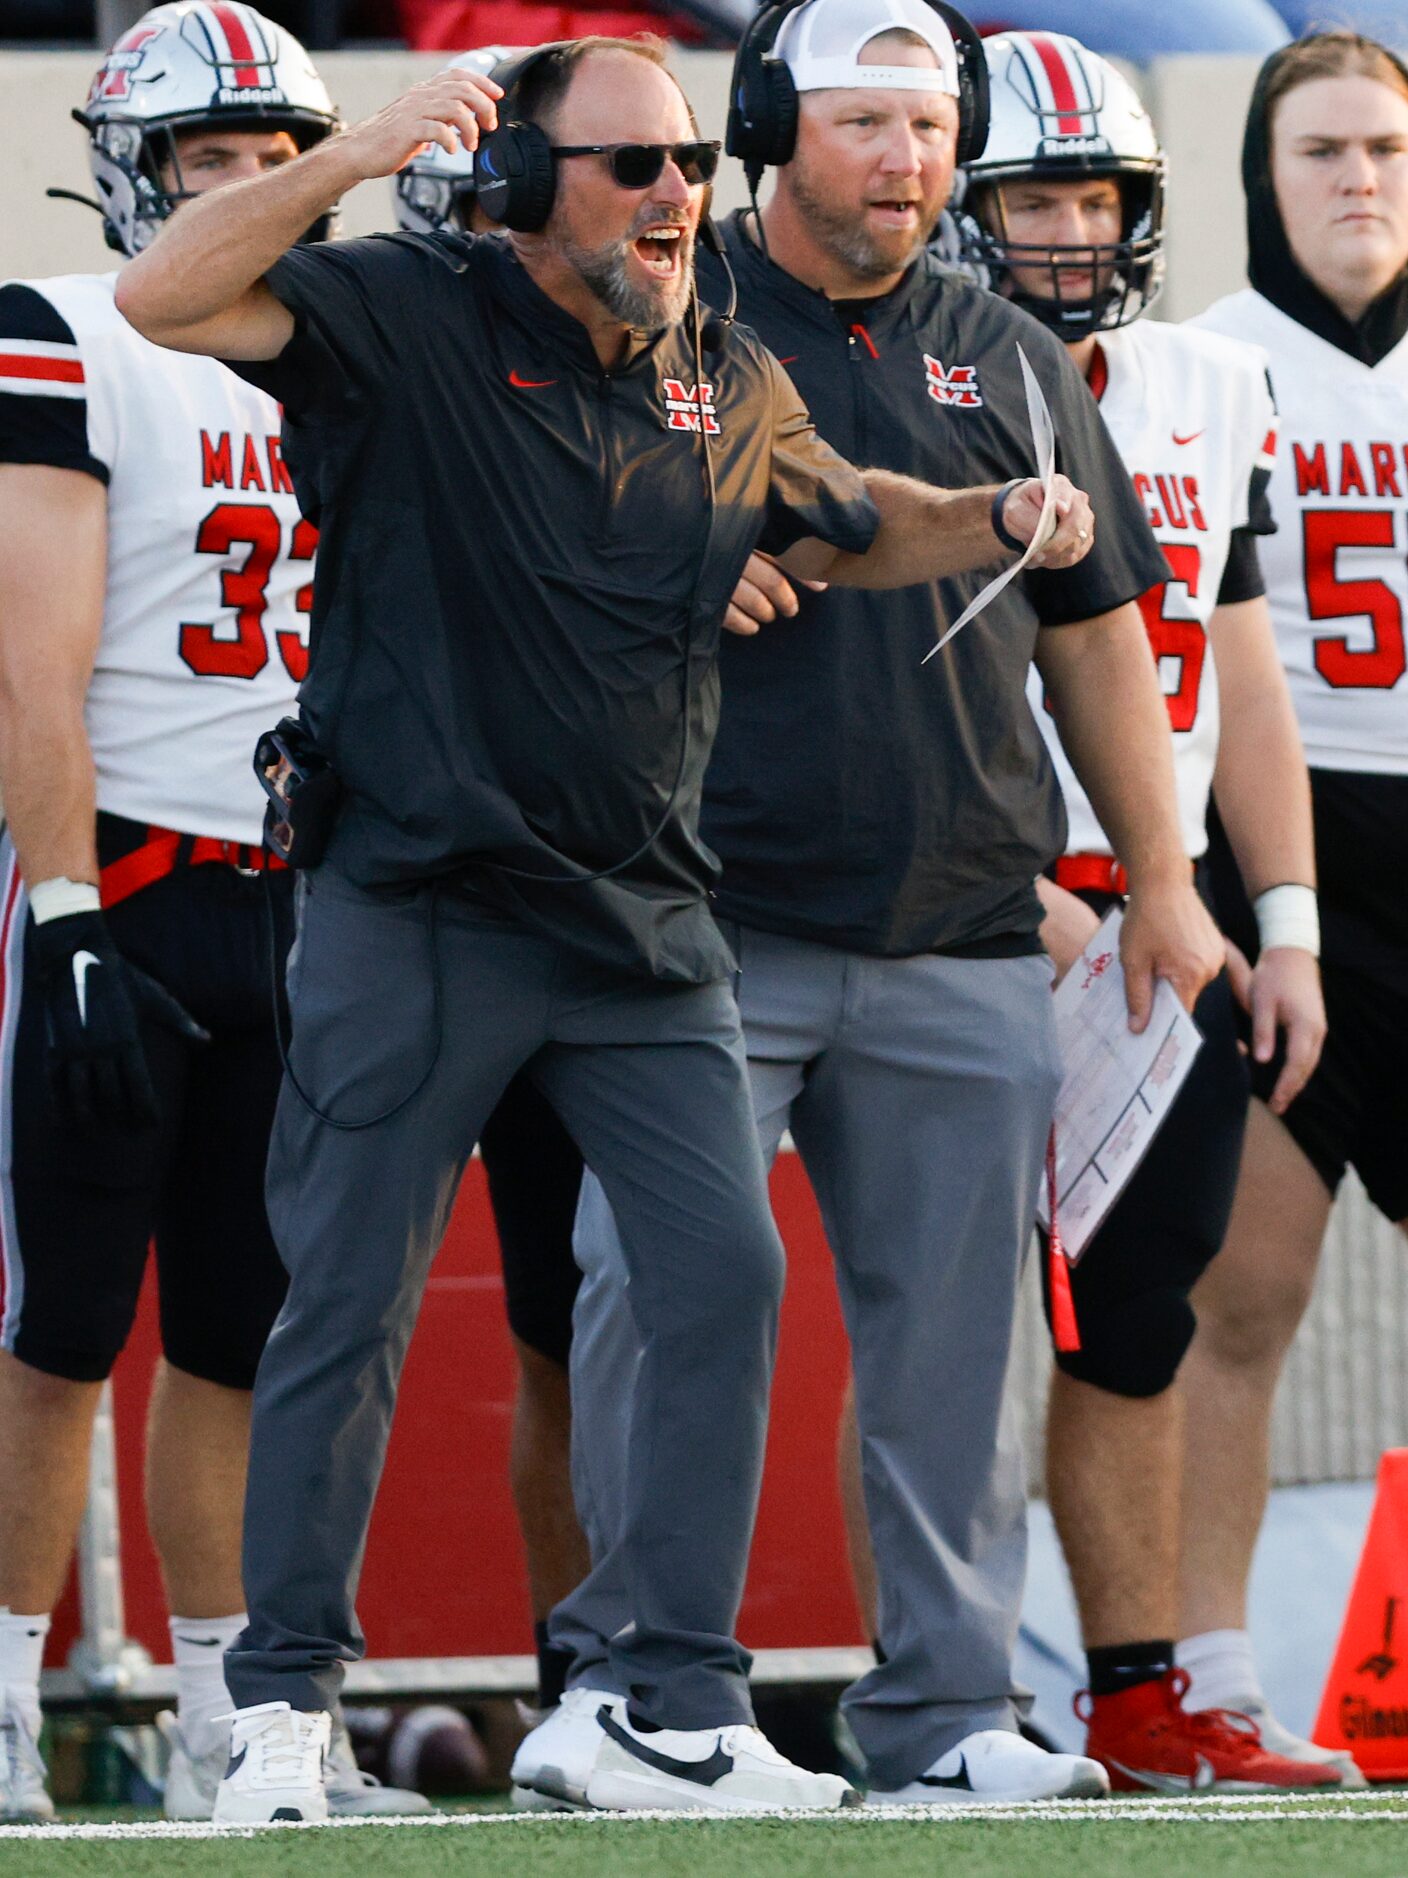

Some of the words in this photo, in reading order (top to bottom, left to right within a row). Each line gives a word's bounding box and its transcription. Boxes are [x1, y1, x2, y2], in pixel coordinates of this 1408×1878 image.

[219, 88, 283, 104] Riddell
[1043, 137, 1108, 155] Riddell
[1133, 542, 1208, 732] 6
